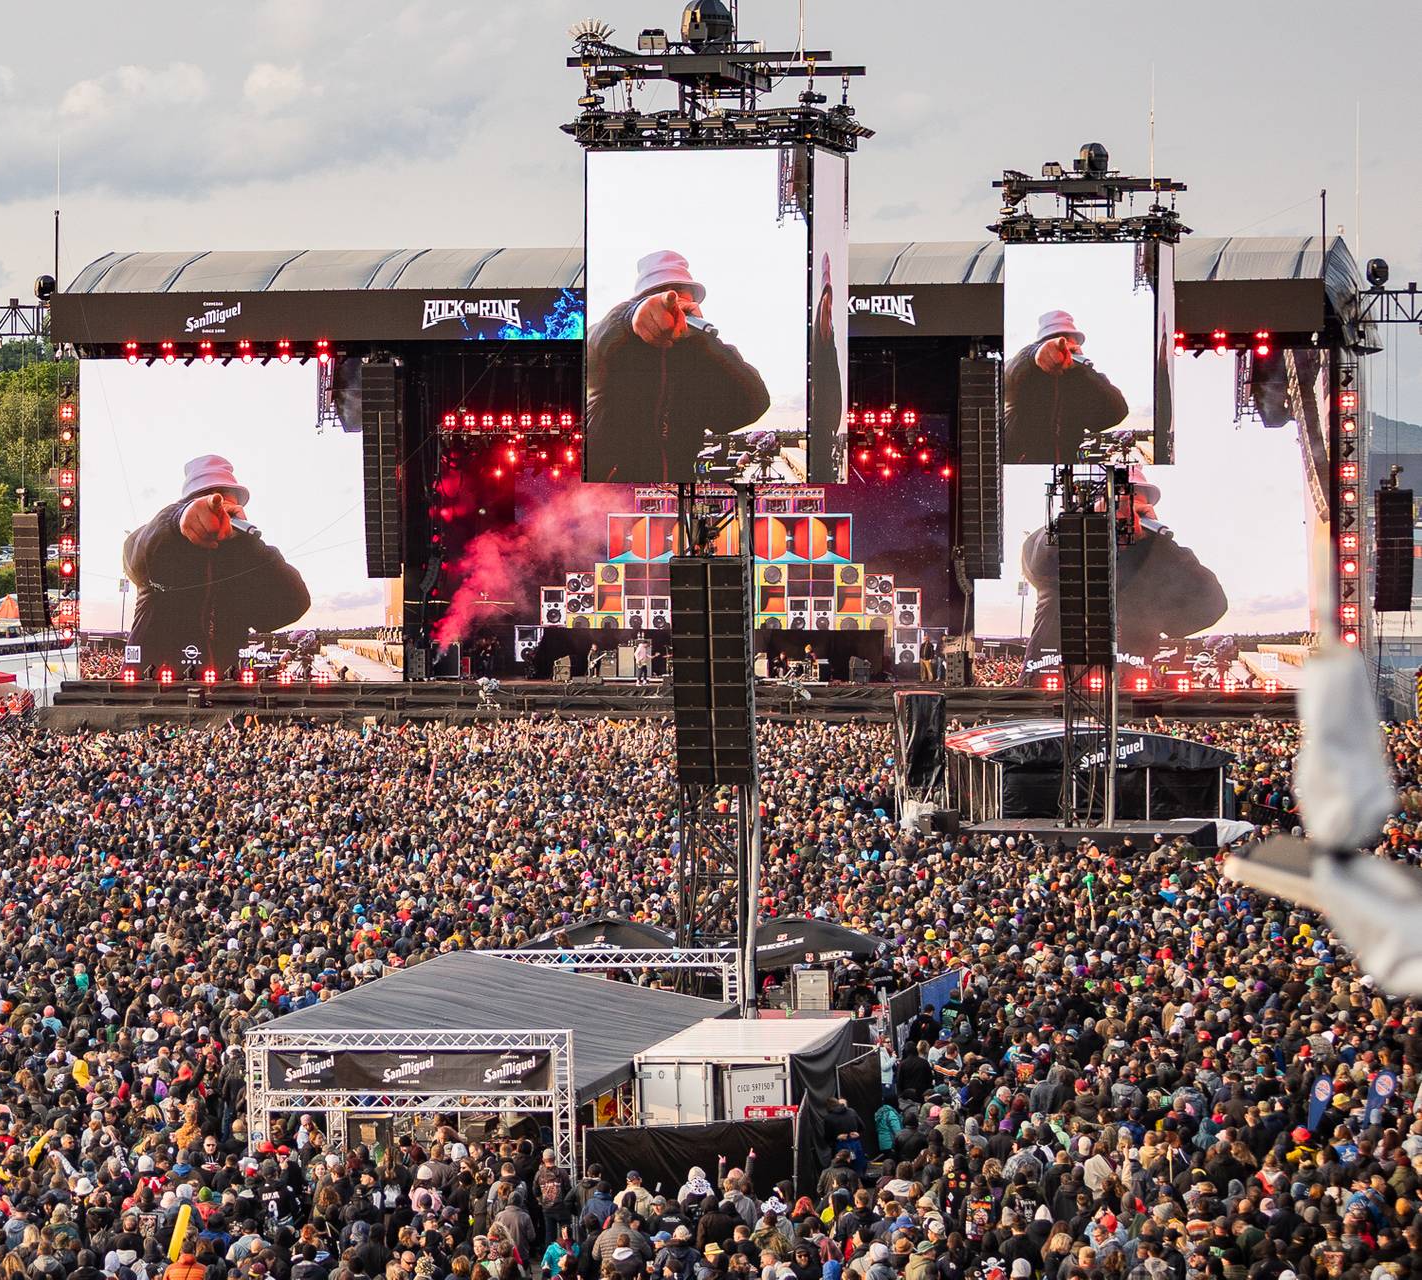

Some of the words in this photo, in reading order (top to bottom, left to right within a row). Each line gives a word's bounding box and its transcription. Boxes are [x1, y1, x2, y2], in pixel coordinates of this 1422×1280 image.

[421, 299, 466, 330] ROCK
[464, 302, 479, 314] AM
[479, 299, 522, 329] RING
[870, 295, 916, 326] RING
